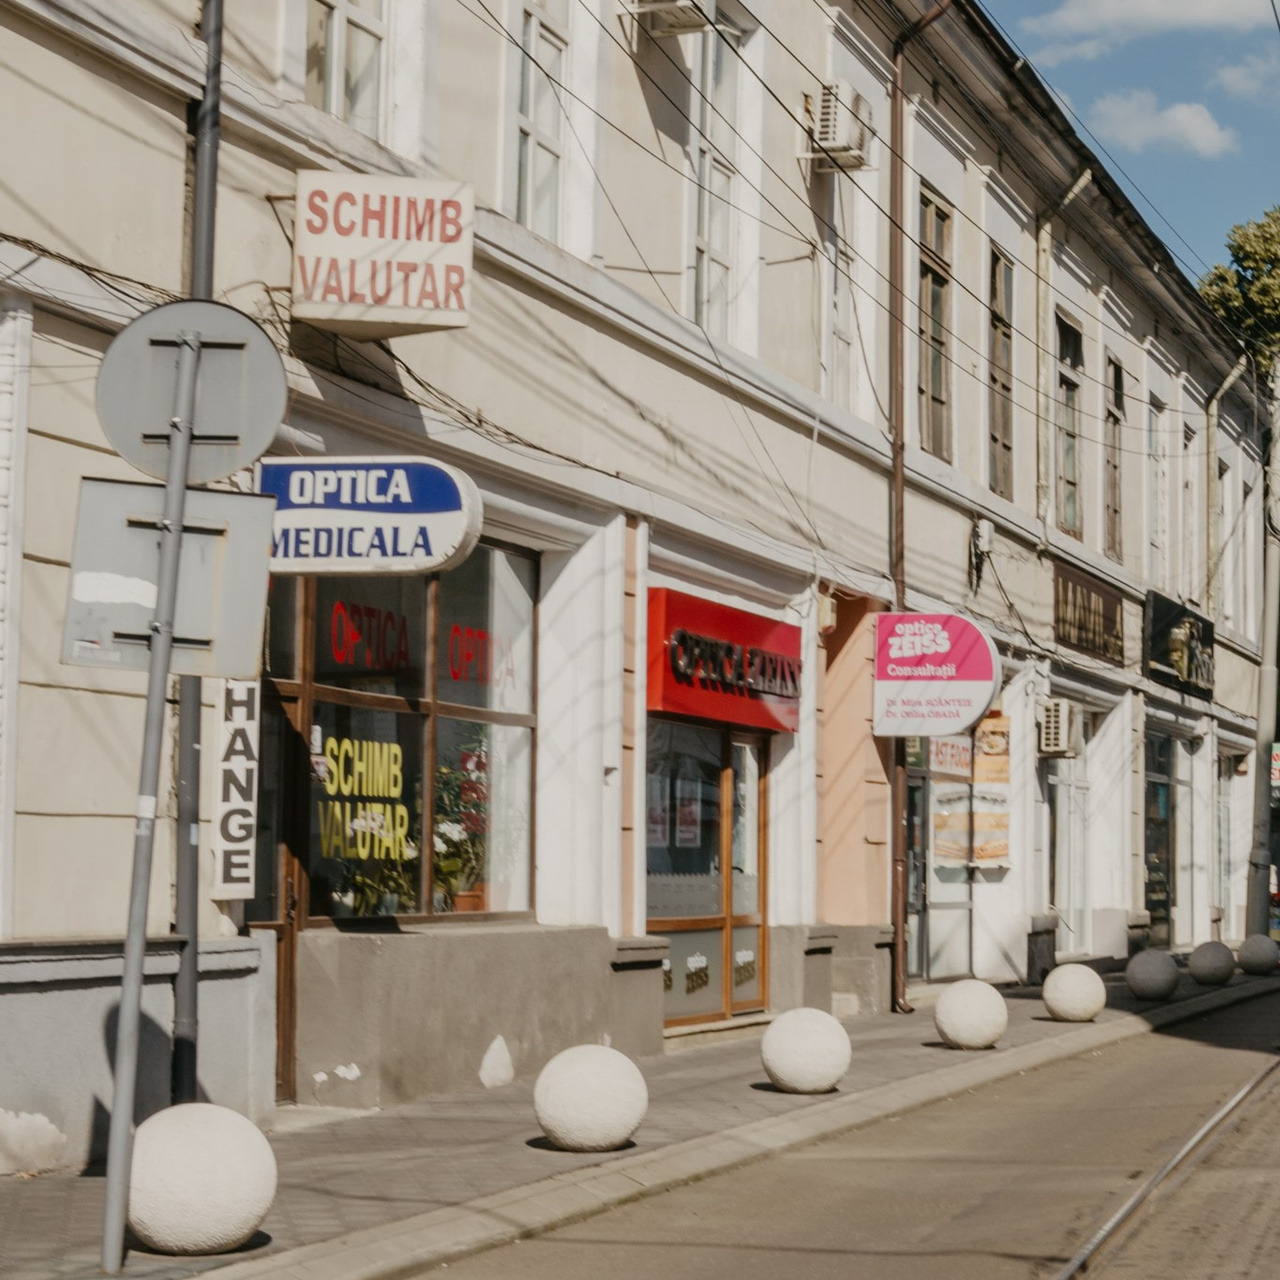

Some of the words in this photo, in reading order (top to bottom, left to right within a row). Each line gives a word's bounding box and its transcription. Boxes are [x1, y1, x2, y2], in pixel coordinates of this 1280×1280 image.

[306, 190, 463, 243] SCHIMB
[298, 256, 465, 310] VALUTAR
[289, 470, 413, 504] OPTICA
[272, 526, 433, 558] MEDICALA
[331, 601, 410, 671] OPTICA
[450, 624, 516, 689] OPTICA
[671, 628, 746, 688] OPTICA
[888, 631, 951, 659] ZEISS
[325, 736, 403, 798] SCHIMB
[318, 801, 409, 860] VALUTAR
